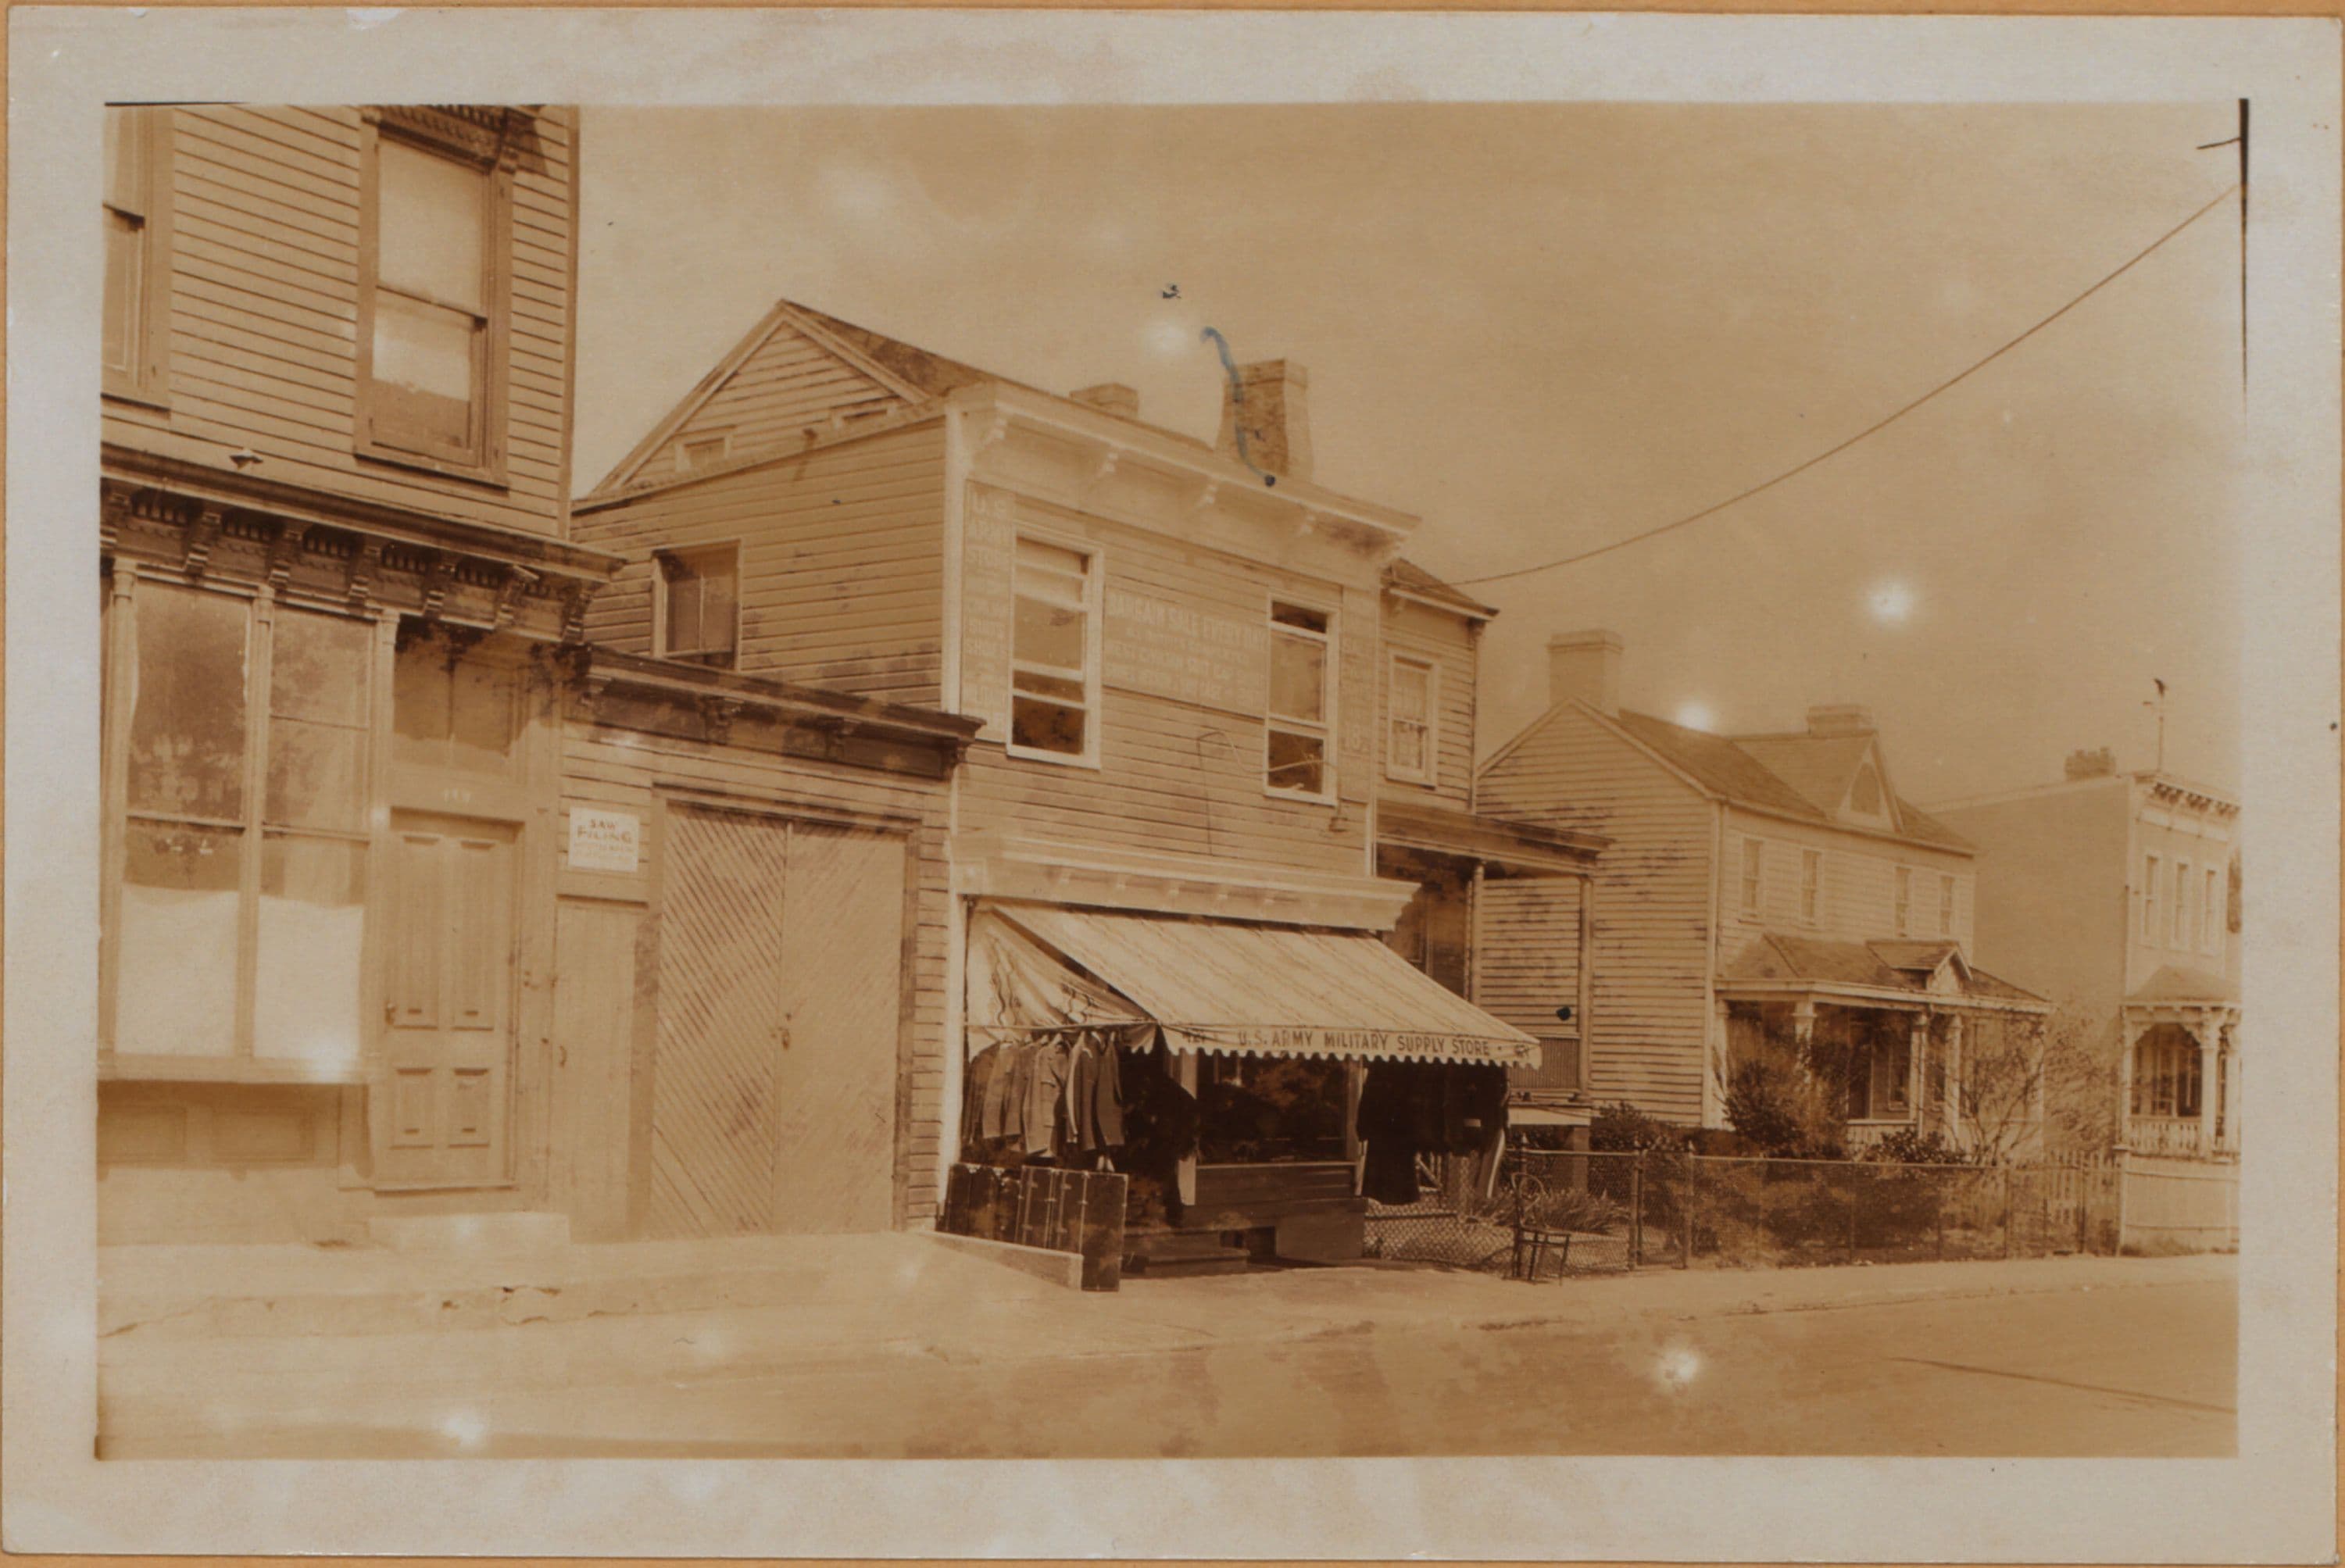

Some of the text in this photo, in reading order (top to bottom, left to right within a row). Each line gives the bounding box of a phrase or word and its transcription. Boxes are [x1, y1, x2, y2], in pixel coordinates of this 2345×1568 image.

[1106, 591, 1165, 627] BARGAIN
[1168, 606, 1201, 638] SALE
[577, 824, 633, 844] FILING
[1238, 1030, 1267, 1045] U.S.
[1273, 1029, 1313, 1047] ARMY
[1324, 1030, 1389, 1050] MILITARY
[1396, 1034, 1445, 1053] SUPPLY
[1451, 1037, 1490, 1056] STORE
